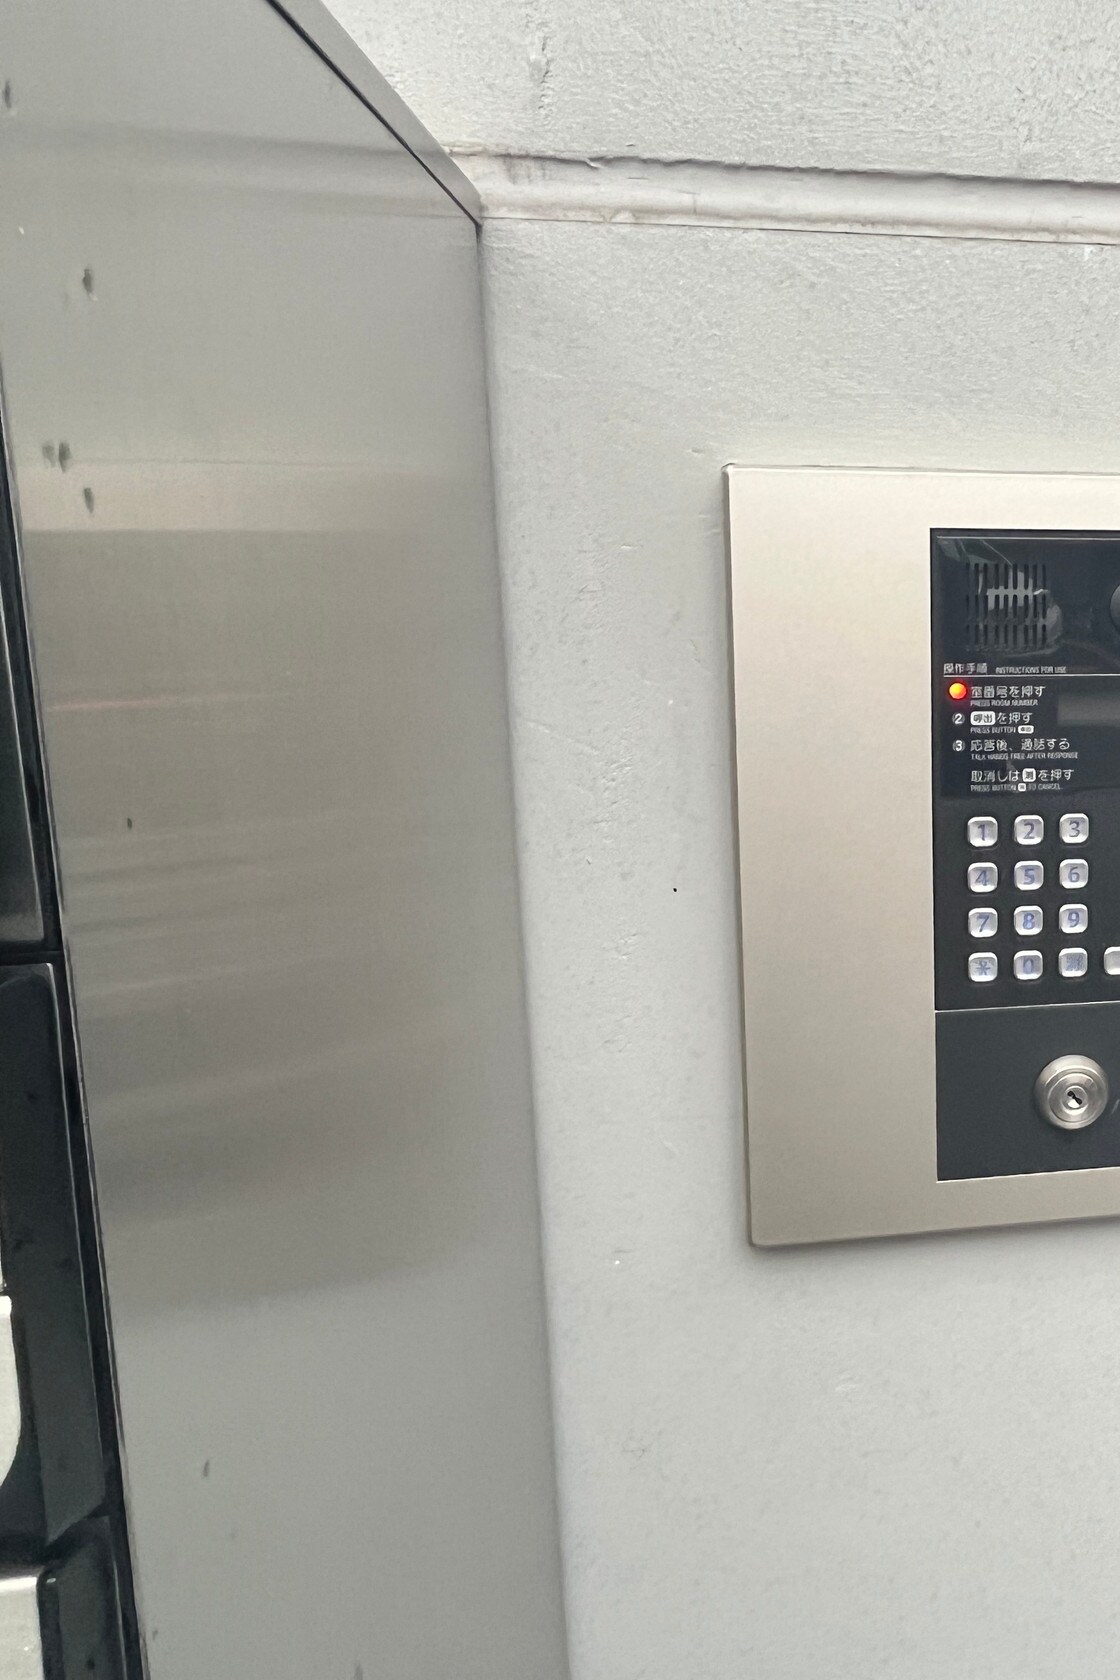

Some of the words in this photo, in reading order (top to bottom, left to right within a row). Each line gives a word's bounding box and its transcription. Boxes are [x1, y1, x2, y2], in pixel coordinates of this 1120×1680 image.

[1040, 666, 1054, 674] FOR
[970, 685, 1046, 698] 室番号を押す
[977, 824, 986, 841] 1
[1023, 822, 1035, 839] 2
[1068, 820, 1080, 838] 3
[975, 869, 989, 887] 4
[1023, 868, 1035, 885] 5
[1068, 866, 1080, 883] 6
[976, 914, 990, 932] 7
[1022, 912, 1035, 930] 8
[1067, 911, 1080, 928] 9
[1022, 957, 1034, 975] 0
